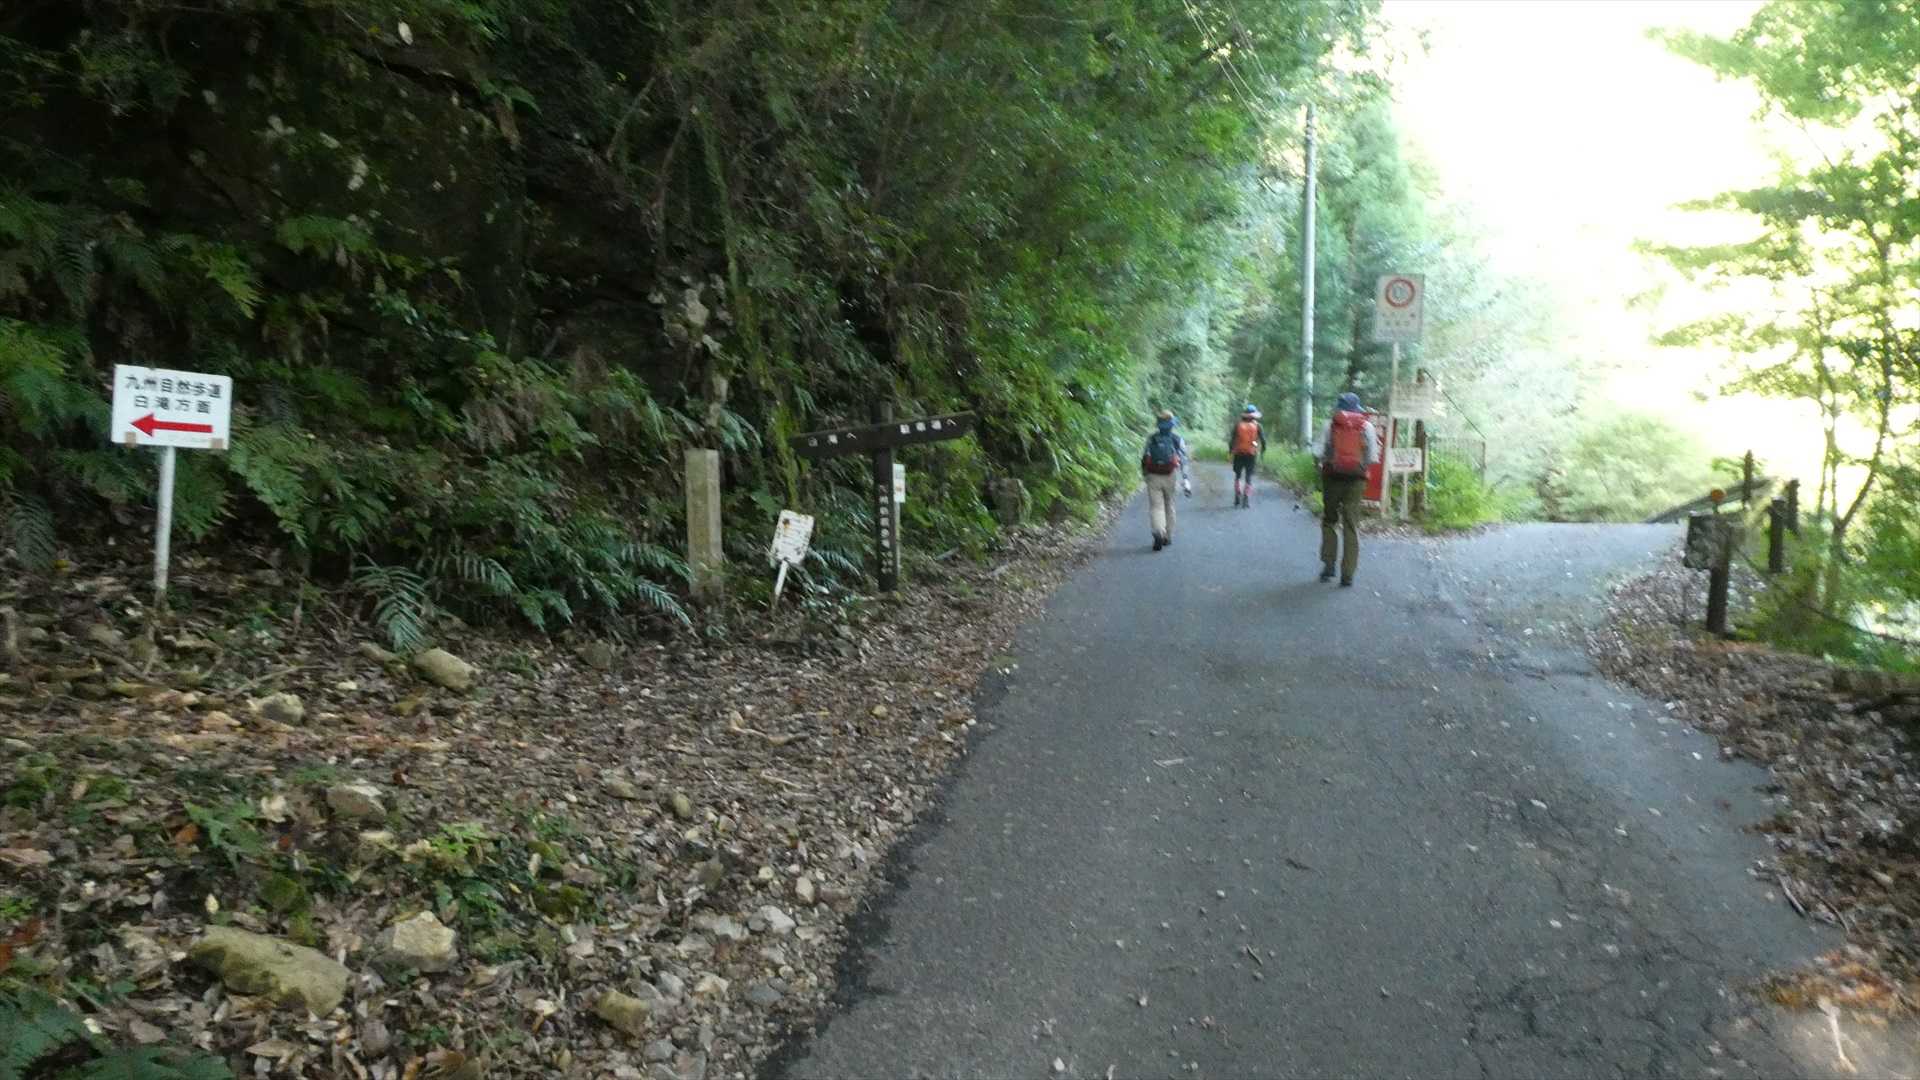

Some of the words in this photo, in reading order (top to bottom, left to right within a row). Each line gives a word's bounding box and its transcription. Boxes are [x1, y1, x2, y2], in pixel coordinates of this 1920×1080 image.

[125, 374, 222, 398] 九州自然歩道
[134, 395, 211, 414] 白滝方面
